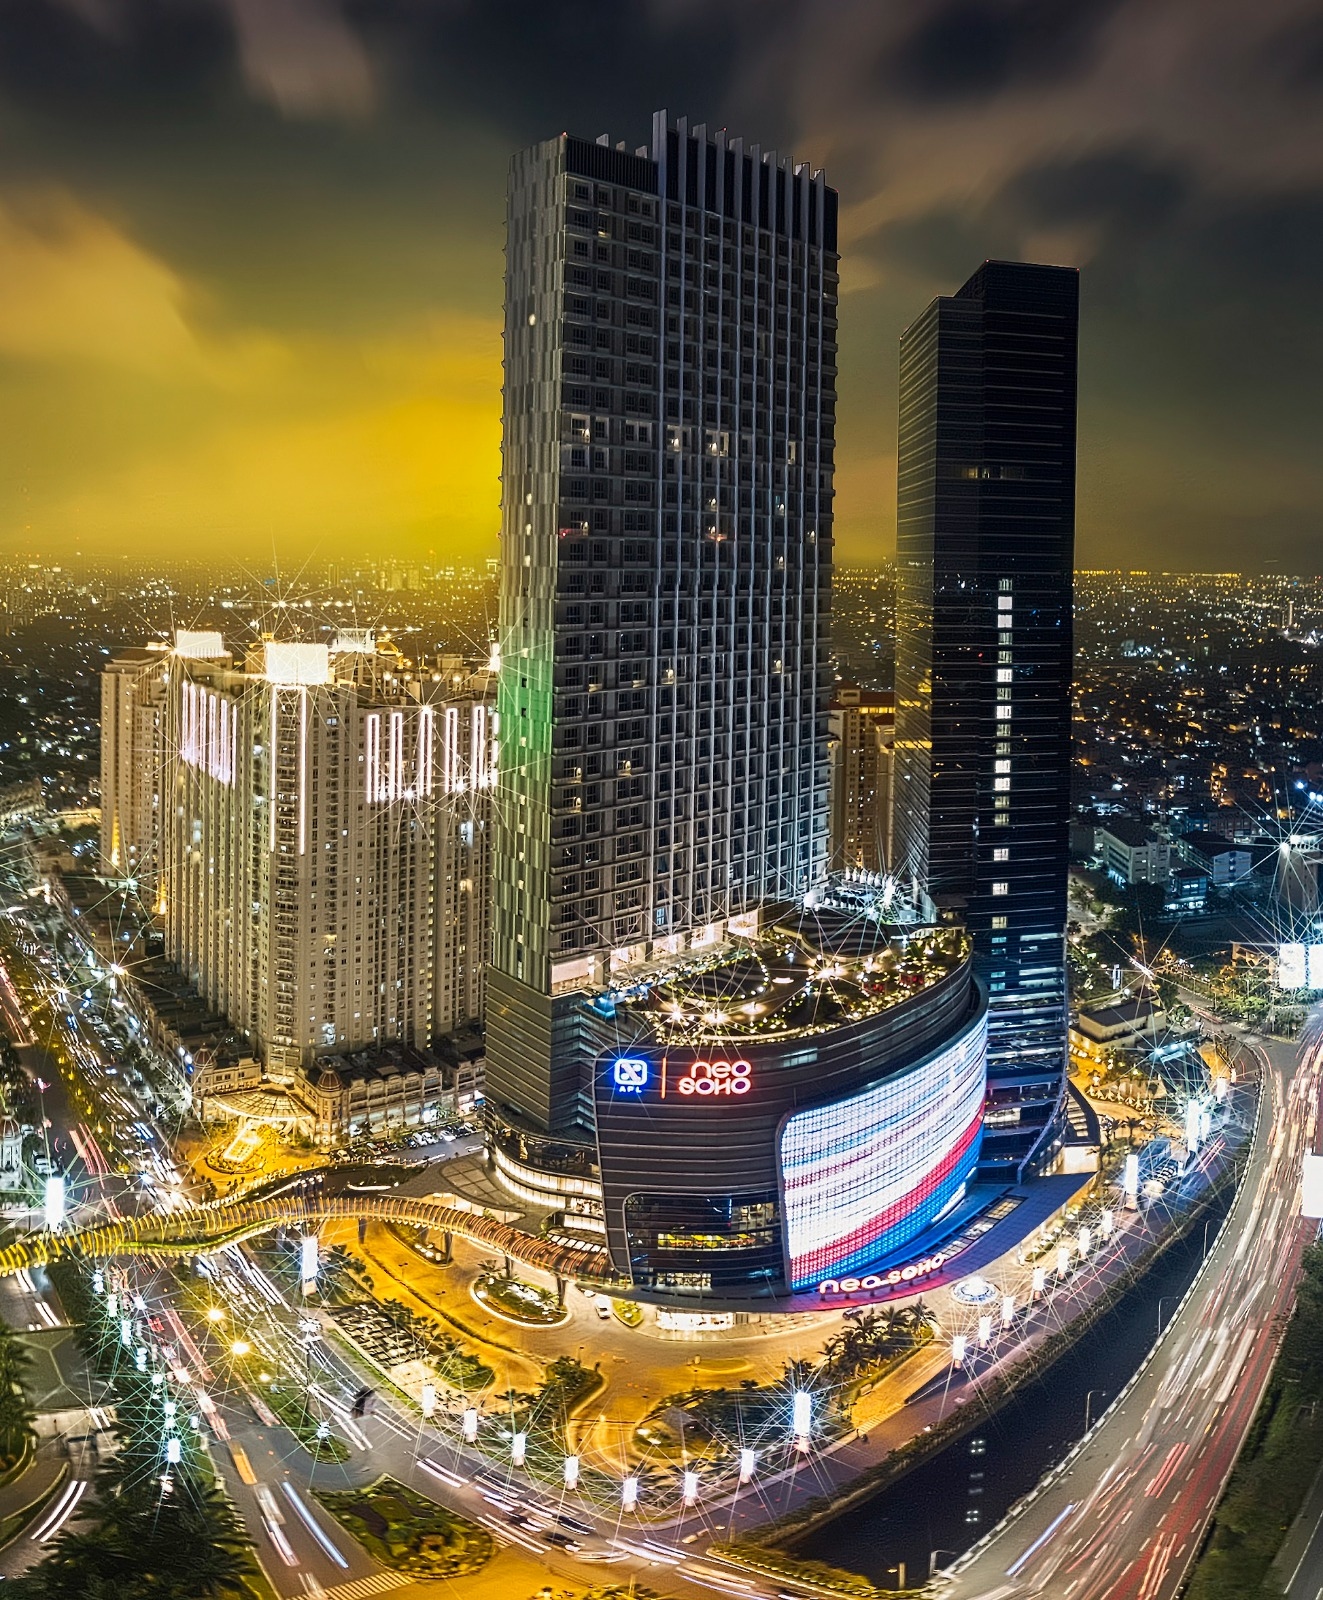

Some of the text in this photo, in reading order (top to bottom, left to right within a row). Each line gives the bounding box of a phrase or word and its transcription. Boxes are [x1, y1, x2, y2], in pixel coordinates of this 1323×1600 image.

[691, 1060, 752, 1078] neo
[618, 1085, 643, 1094] APL
[678, 1077, 752, 1096] SOHO
